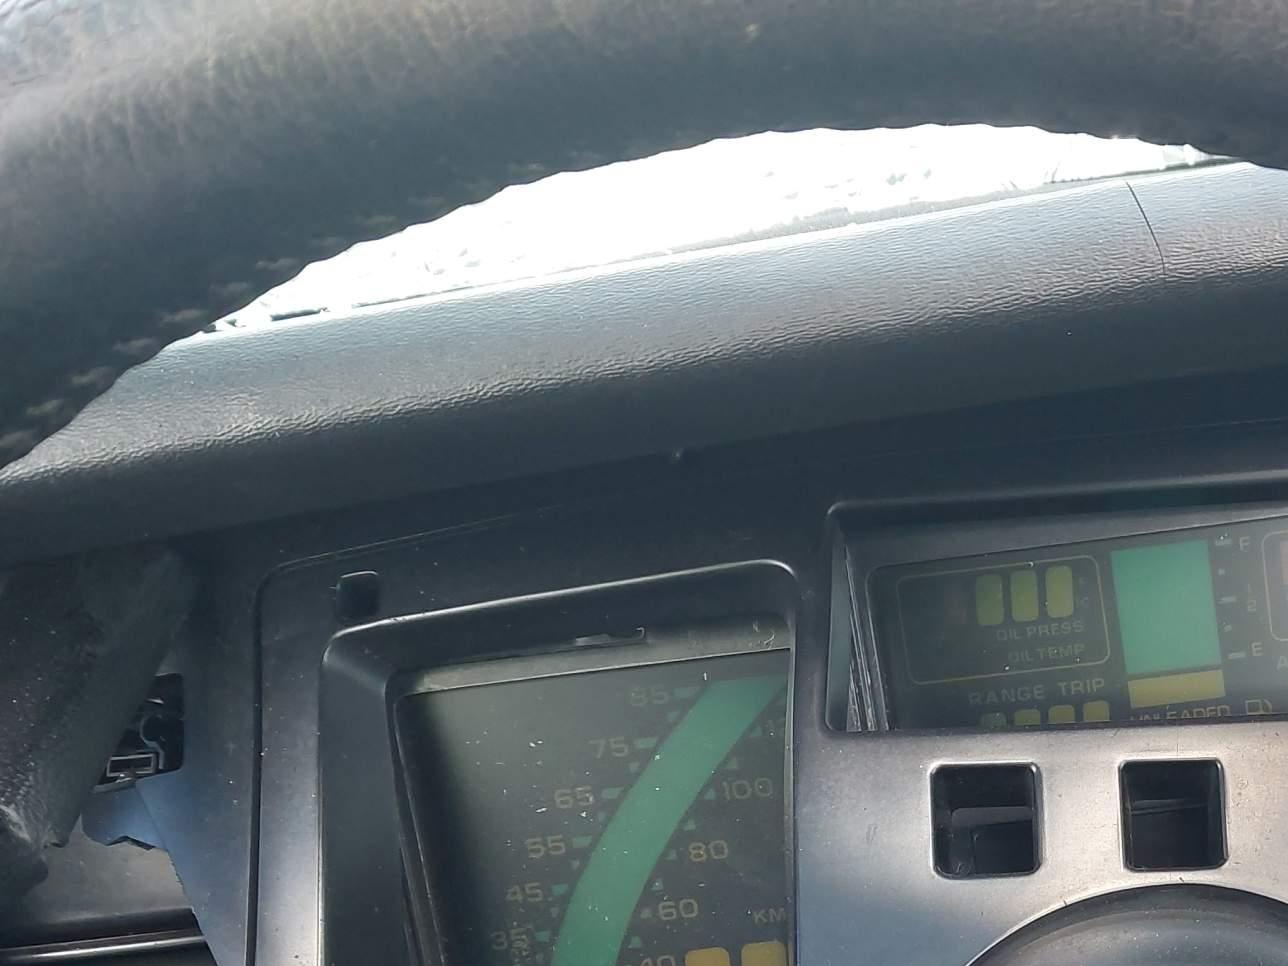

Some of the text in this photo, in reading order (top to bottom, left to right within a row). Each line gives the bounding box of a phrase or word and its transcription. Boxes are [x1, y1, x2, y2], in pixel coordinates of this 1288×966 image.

[1239, 536, 1251, 552] F
[996, 619, 1085, 642] OIL PRESS
[1008, 643, 1087, 663] OIL TEMP
[1251, 642, 1264, 657] E
[967, 677, 1106, 706] RANGE TRIP
[587, 735, 629, 760] 75
[553, 785, 595, 810] 65
[721, 776, 774, 801] 100
[526, 833, 566, 859] 55
[687, 839, 729, 862] 80
[504, 881, 544, 904] 45
[657, 897, 699, 922] 60
[491, 927, 530, 952] 35
